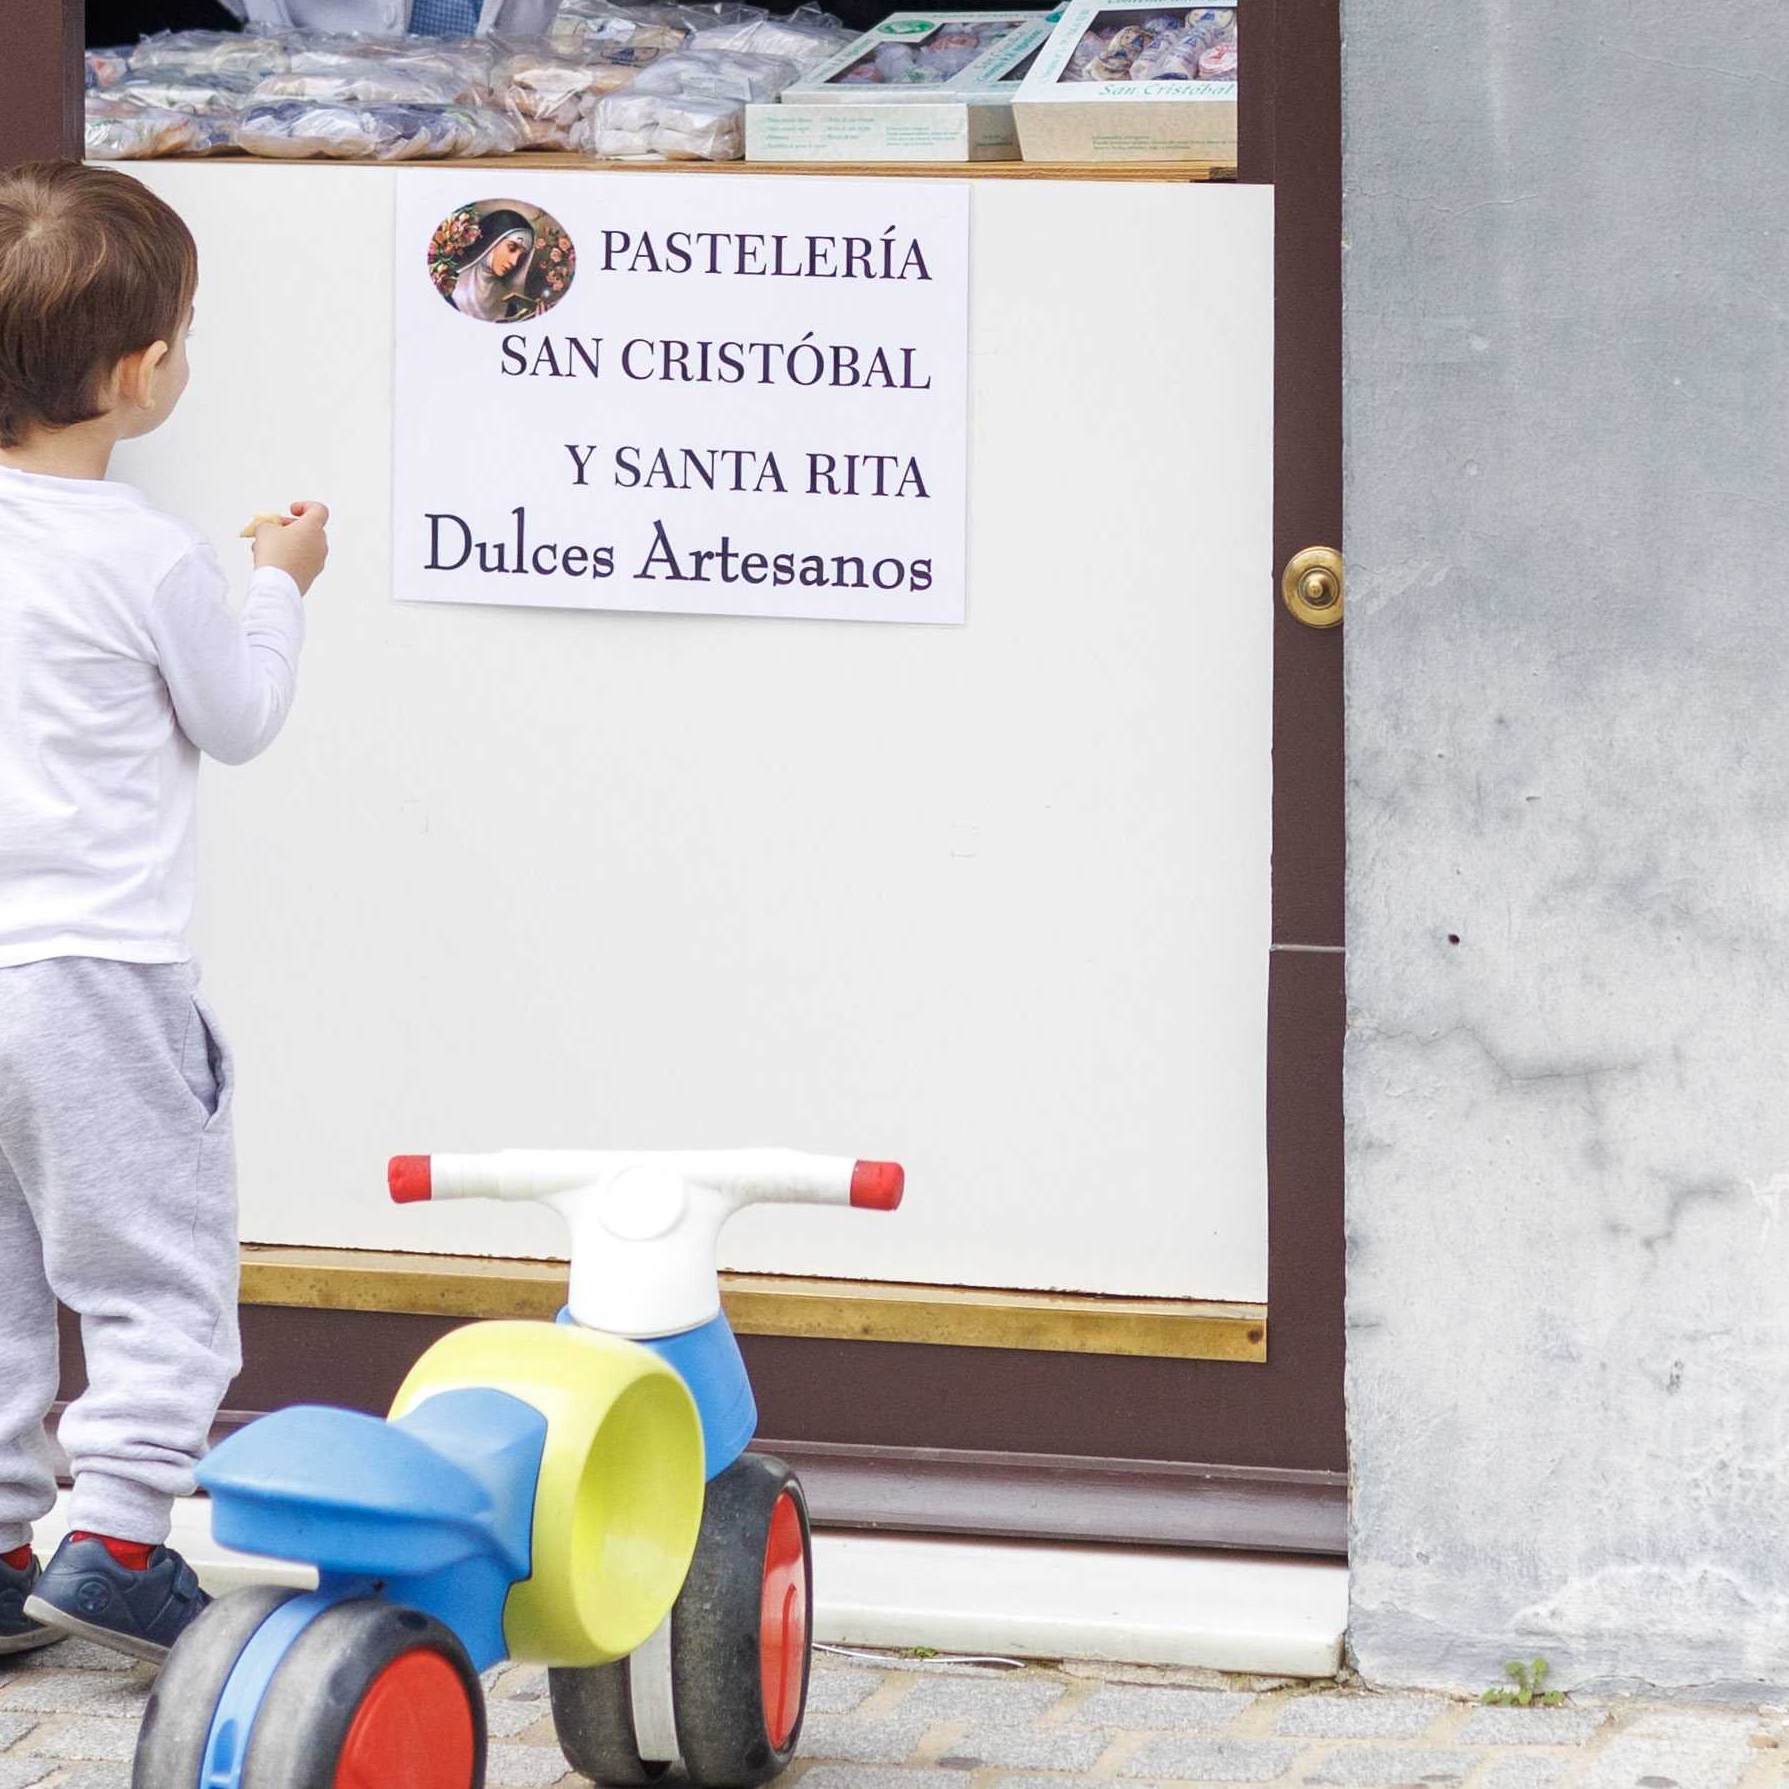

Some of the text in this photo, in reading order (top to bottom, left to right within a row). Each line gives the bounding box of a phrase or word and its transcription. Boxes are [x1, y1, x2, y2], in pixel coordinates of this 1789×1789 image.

[1099, 83, 1235, 96] San Cristóbal
[601, 225, 932, 280] PASTELERÍA
[502, 332, 930, 389] SAN CRISTÓBAL
[564, 445, 930, 498] Y SANTA RITA
[424, 507, 932, 592] Dulces Artesanos
